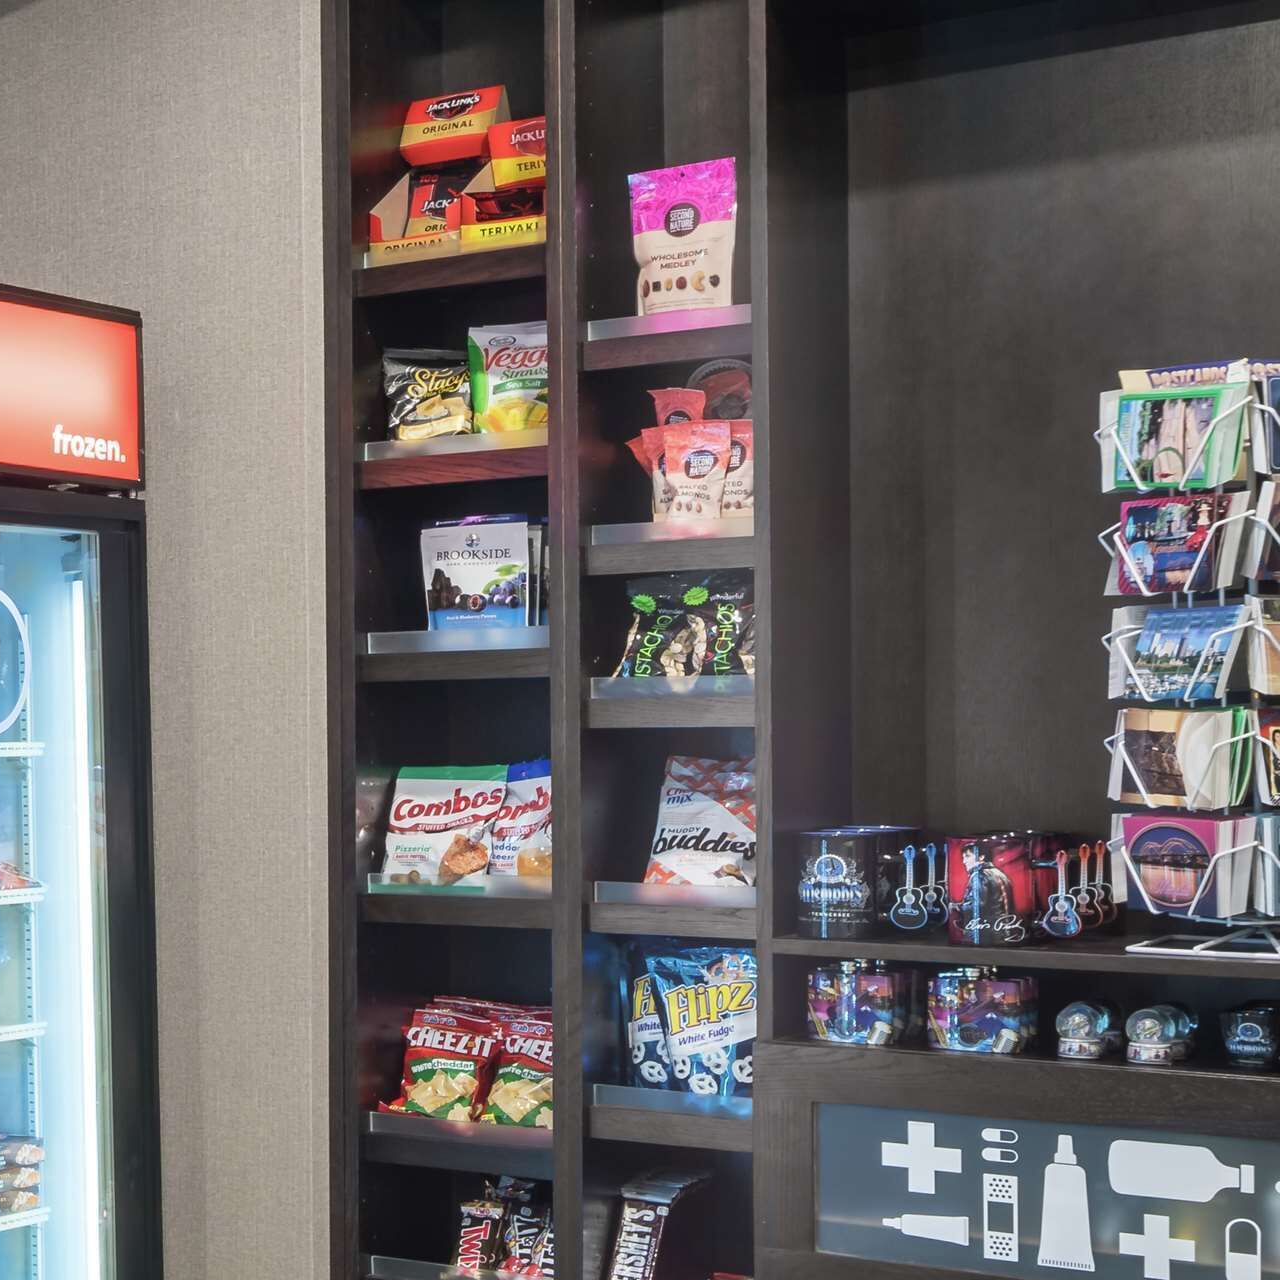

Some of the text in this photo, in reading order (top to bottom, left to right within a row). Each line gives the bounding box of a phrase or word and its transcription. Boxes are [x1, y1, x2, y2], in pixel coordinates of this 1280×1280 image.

[423, 119, 475, 135] ORIGINAL
[510, 131, 536, 144] JACK
[480, 223, 539, 237] TERIYAKI
[650, 248, 709, 262] WHOLESOME
[660, 259, 697, 270] MEDLEY
[52, 424, 126, 463] frozen.
[436, 548, 512, 561] BROOKSIDE
[393, 787, 506, 821] Combos
[666, 793, 694, 805] mix
[395, 844, 432, 853] Pizzeria
[653, 827, 757, 861] buddies
[665, 980, 755, 1034] Flipz
[678, 1025, 735, 1046] White Fudge
[433, 1060, 475, 1070] cheddar
